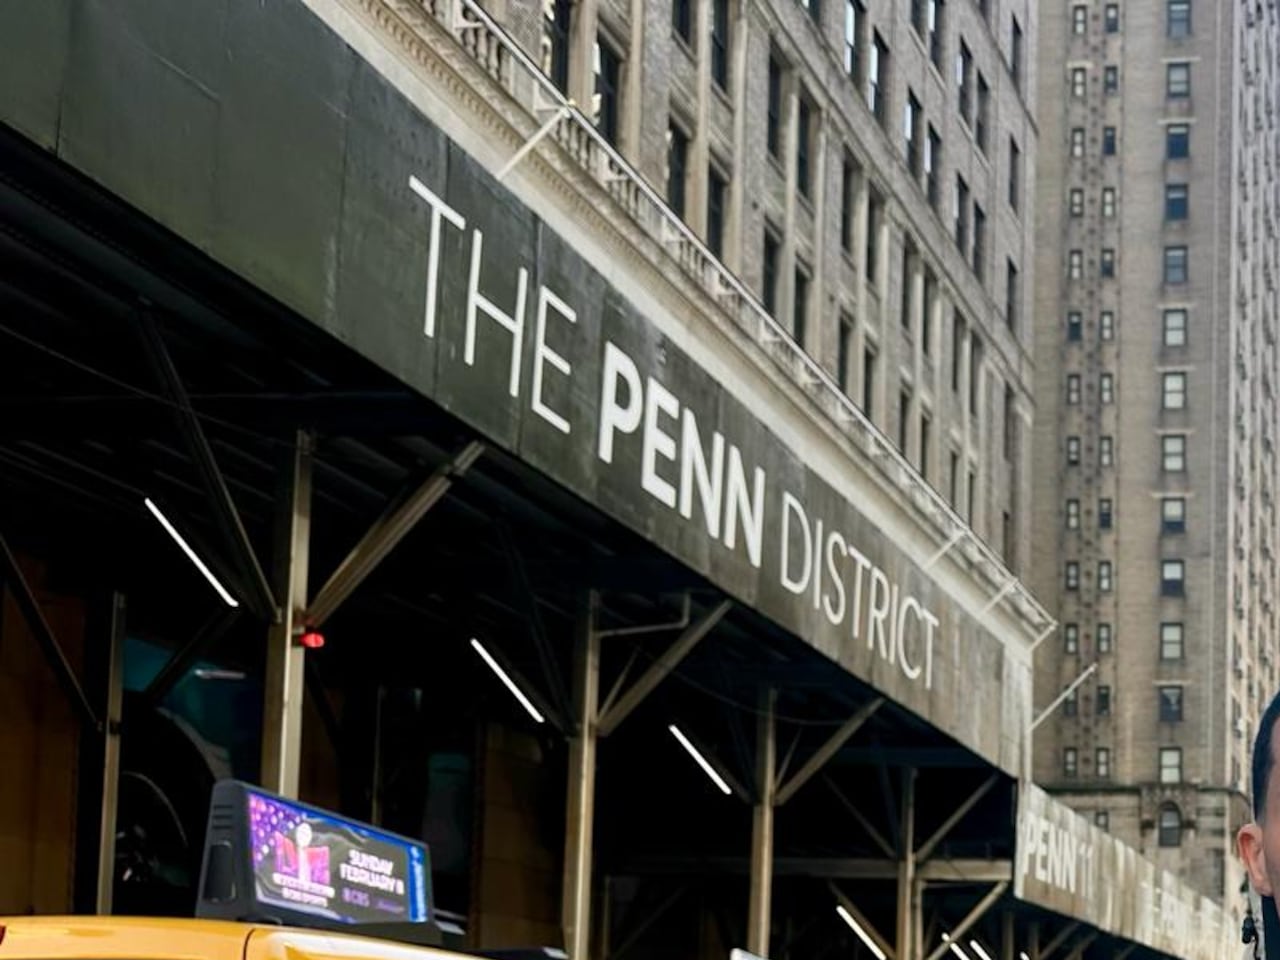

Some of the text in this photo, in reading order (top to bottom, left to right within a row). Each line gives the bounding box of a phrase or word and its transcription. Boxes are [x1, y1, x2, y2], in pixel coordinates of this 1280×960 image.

[409, 174, 940, 690] THE PENN DISTRICT
[1023, 811, 1077, 894] PENN
